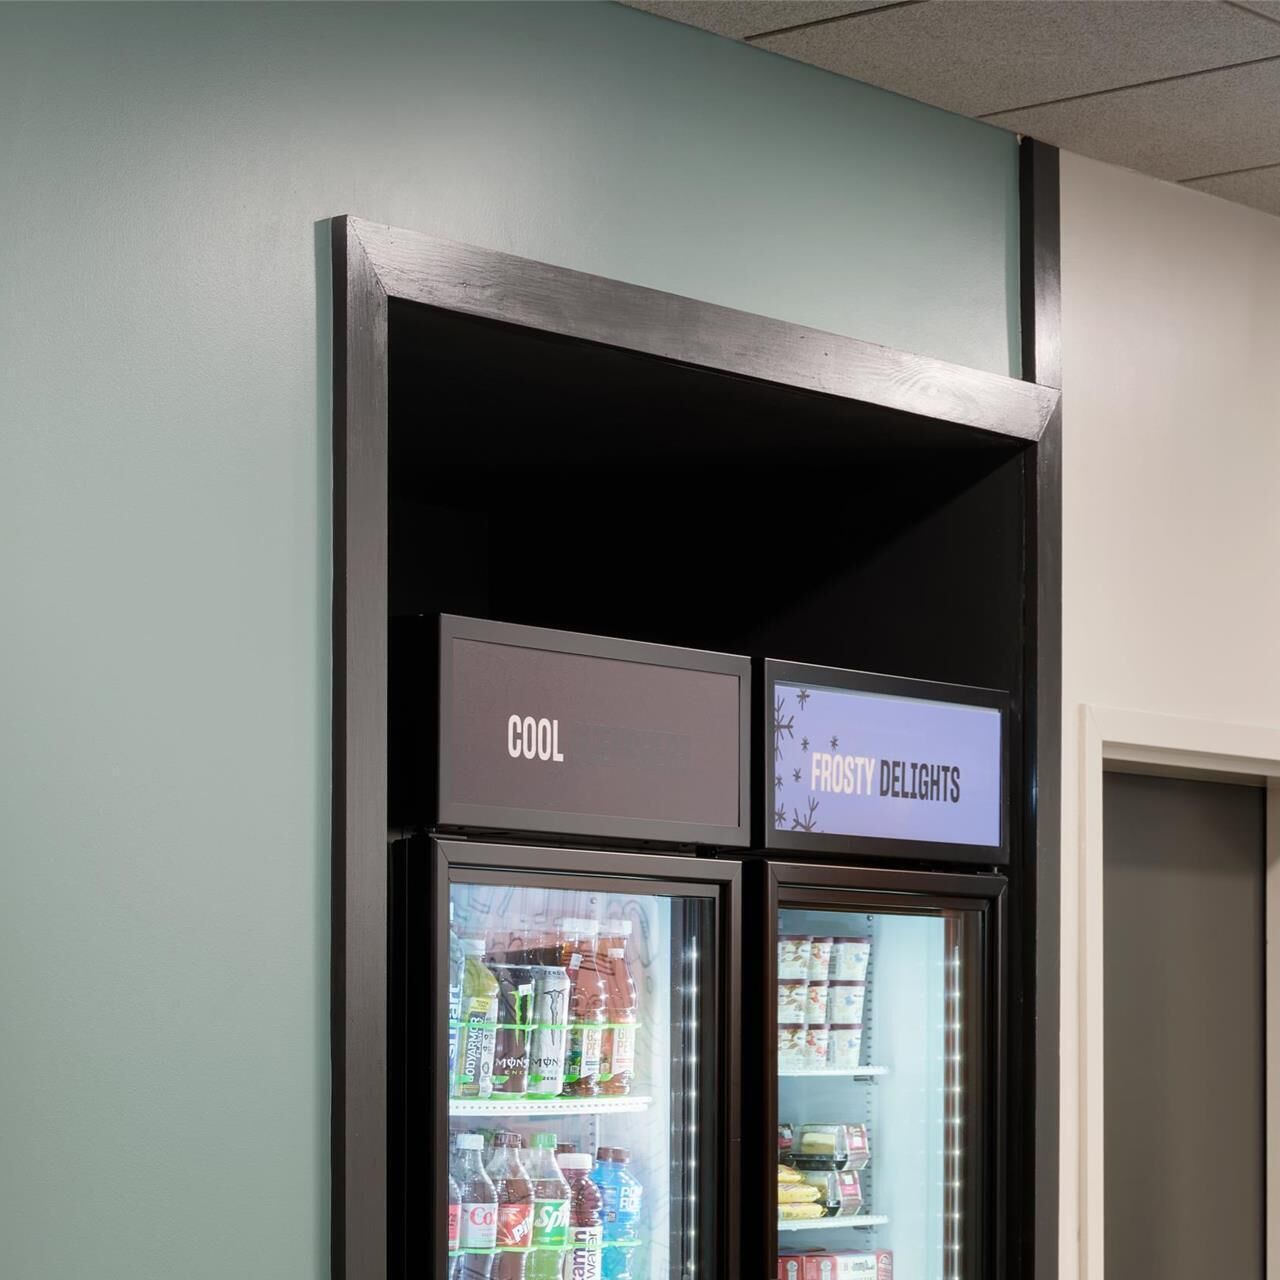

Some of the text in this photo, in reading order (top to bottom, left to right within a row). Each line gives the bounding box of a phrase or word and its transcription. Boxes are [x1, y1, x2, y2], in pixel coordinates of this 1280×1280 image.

[507, 714, 564, 762] COOL
[811, 751, 960, 804] FROSTY DELIGHTS
